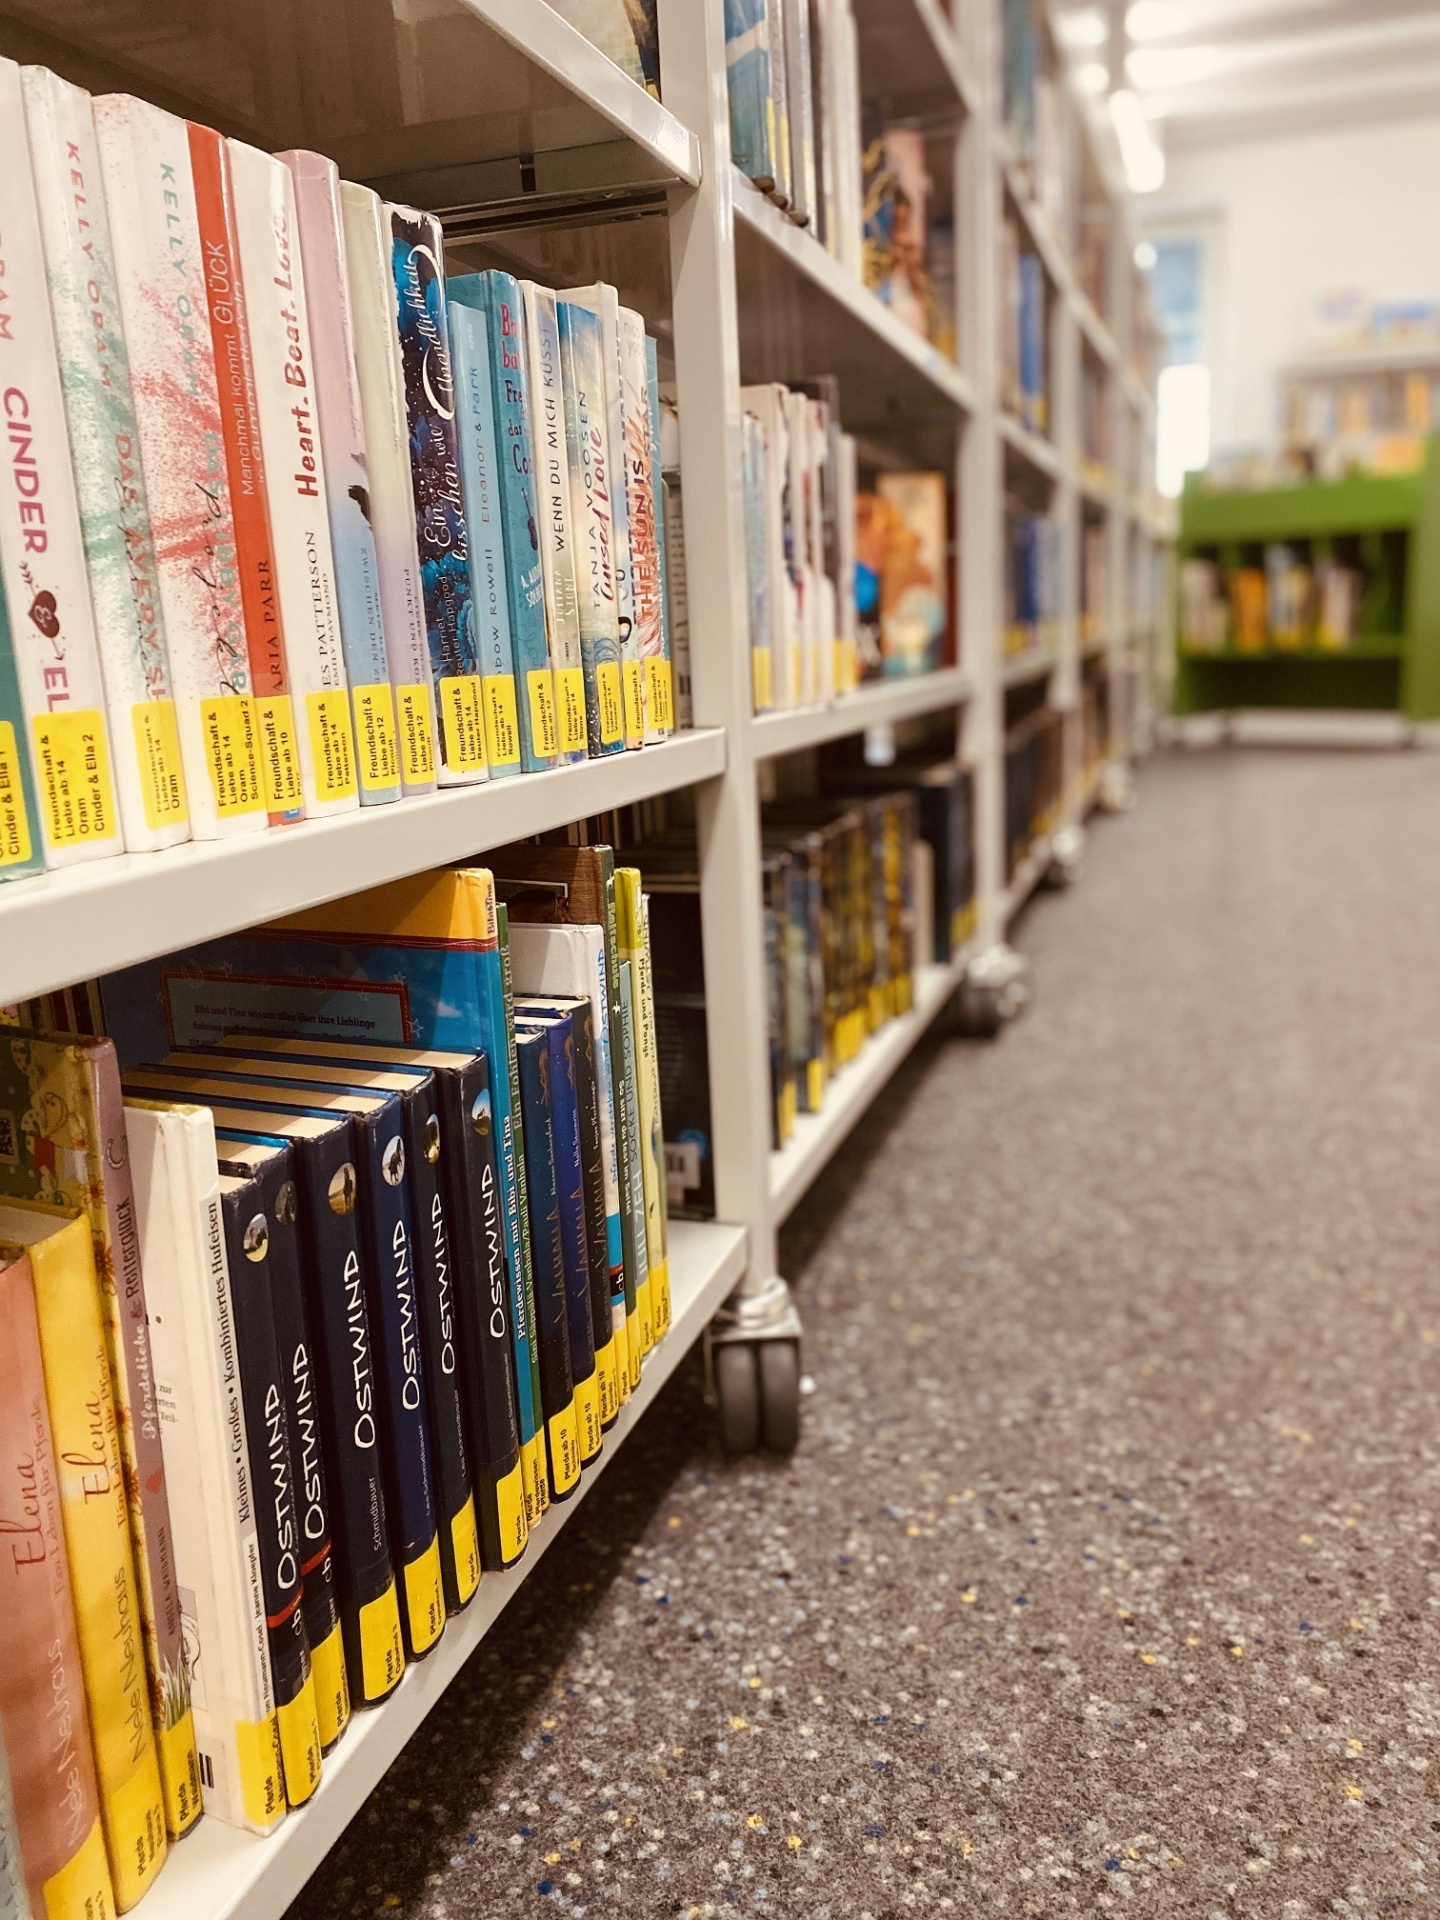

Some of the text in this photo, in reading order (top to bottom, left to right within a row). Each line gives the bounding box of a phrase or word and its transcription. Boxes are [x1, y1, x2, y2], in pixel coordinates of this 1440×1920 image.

[67, 141, 112, 388] KELLY ORAM
[160, 162, 201, 397] KELLY ORAM
[224, 333, 255, 496] Manchmal kommt
[281, 299, 319, 497] Heart. Beat.
[3, 387, 48, 554] CINDER
[424, 426, 468, 561] Ein bisschen wie
[545, 398, 566, 552] WENN DU MICH
[590, 427, 609, 503] Love
[633, 459, 646, 485] IS
[125, 526, 160, 650] AVERY
[258, 560, 276, 623] PARR
[305, 531, 328, 655] PATTERSON
[587, 525, 601, 610] TANJA
[322, 573, 336, 642] RAYMOND
[403, 568, 418, 652] PUNKT UND
[435, 576, 456, 662] Harriet Hapgood
[370, 632, 380, 661] DEN
[361, 696, 379, 779] Freundschaft &
[403, 695, 419, 774] Freundschaft &
[452, 687, 468, 762] Freundschaft &
[465, 705, 476, 761] Liebe ab 14
[537, 682, 550, 751] Freundschaft &
[632, 677, 641, 730] Freundschaft
[208, 711, 227, 807] Freundschaft &
[222, 734, 238, 805] Liebe ab 14
[240, 700, 259, 801] Science-Squad 2
[263, 710, 284, 800] Freundschaft &
[280, 731, 296, 798] Liebe ab 10
[318, 702, 335, 789] Freundschaft &
[330, 723, 344, 787] Liebe ab 14
[340, 732, 351, 785] Patterson
[376, 716, 390, 777] Liebe ab 12
[416, 715, 428, 773] Liebe ab 12
[506, 724, 514, 755] Rowell
[40, 734, 63, 841] Freundschaft &
[57, 760, 75, 837] Liebe ab 14
[78, 797, 90, 835] Oram
[82, 733, 105, 832] Cinder & Ella 2
[168, 773, 180, 809] Oram
[238, 768, 249, 803] Oram
[2, 793, 20, 855] Cinder &
[639, 957, 647, 995] Pferde
[194, 1004, 376, 1029] Bibi und Tina wissen alles über ihre Lieblinge
[501, 944, 522, 1130] Ein Fohlen wird groß
[642, 1023, 650, 1058] Ponys
[625, 1066, 634, 1103] UND
[629, 1109, 639, 1163] SOCKE
[517, 1153, 528, 1203] Vanhala
[481, 1163, 506, 1339] OSTWIND
[502, 1115, 527, 1341] Pferdewissen mit Bibi und Tina
[393, 1219, 421, 1411] OSTWIND
[431, 1193, 456, 1375] OSTWIND
[133, 1323, 157, 1440] Pferdeliebe
[207, 1201, 251, 1524] Kleines Großes Kombiniertes Hufeisen
[344, 1250, 376, 1449] OSTWIND
[530, 1341, 539, 1364] Sini
[598, 1370, 606, 1380] 10
[600, 1380, 607, 1392] ab
[61, 1390, 111, 1505] Elena
[293, 1344, 325, 1539] OSTWIND
[560, 1428, 572, 1481] Pferde ab 10
[584, 1401, 595, 1453] Pferde ab 10
[0, 1451, 46, 1575] Elena
[265, 1384, 298, 1590] OSTWIND
[368, 1477, 383, 1551] Schmidbauer
[526, 1493, 534, 1523] Pferde
[539, 1477, 547, 1506] Pferde
[515, 1514, 524, 1546] Pferde
[469, 1551, 477, 1585] Pferde
[428, 1602, 437, 1636] Pferde
[113, 1566, 147, 1763] Nele Neuhaus
[386, 1649, 395, 1685] Pferde
[45, 1639, 77, 1774] Neuhaus
[336, 1690, 345, 1728] Pferde
[177, 1782, 189, 1823] Pferde
[265, 1774, 274, 1815] Pferde
[135, 1836, 147, 1877] Pferde
